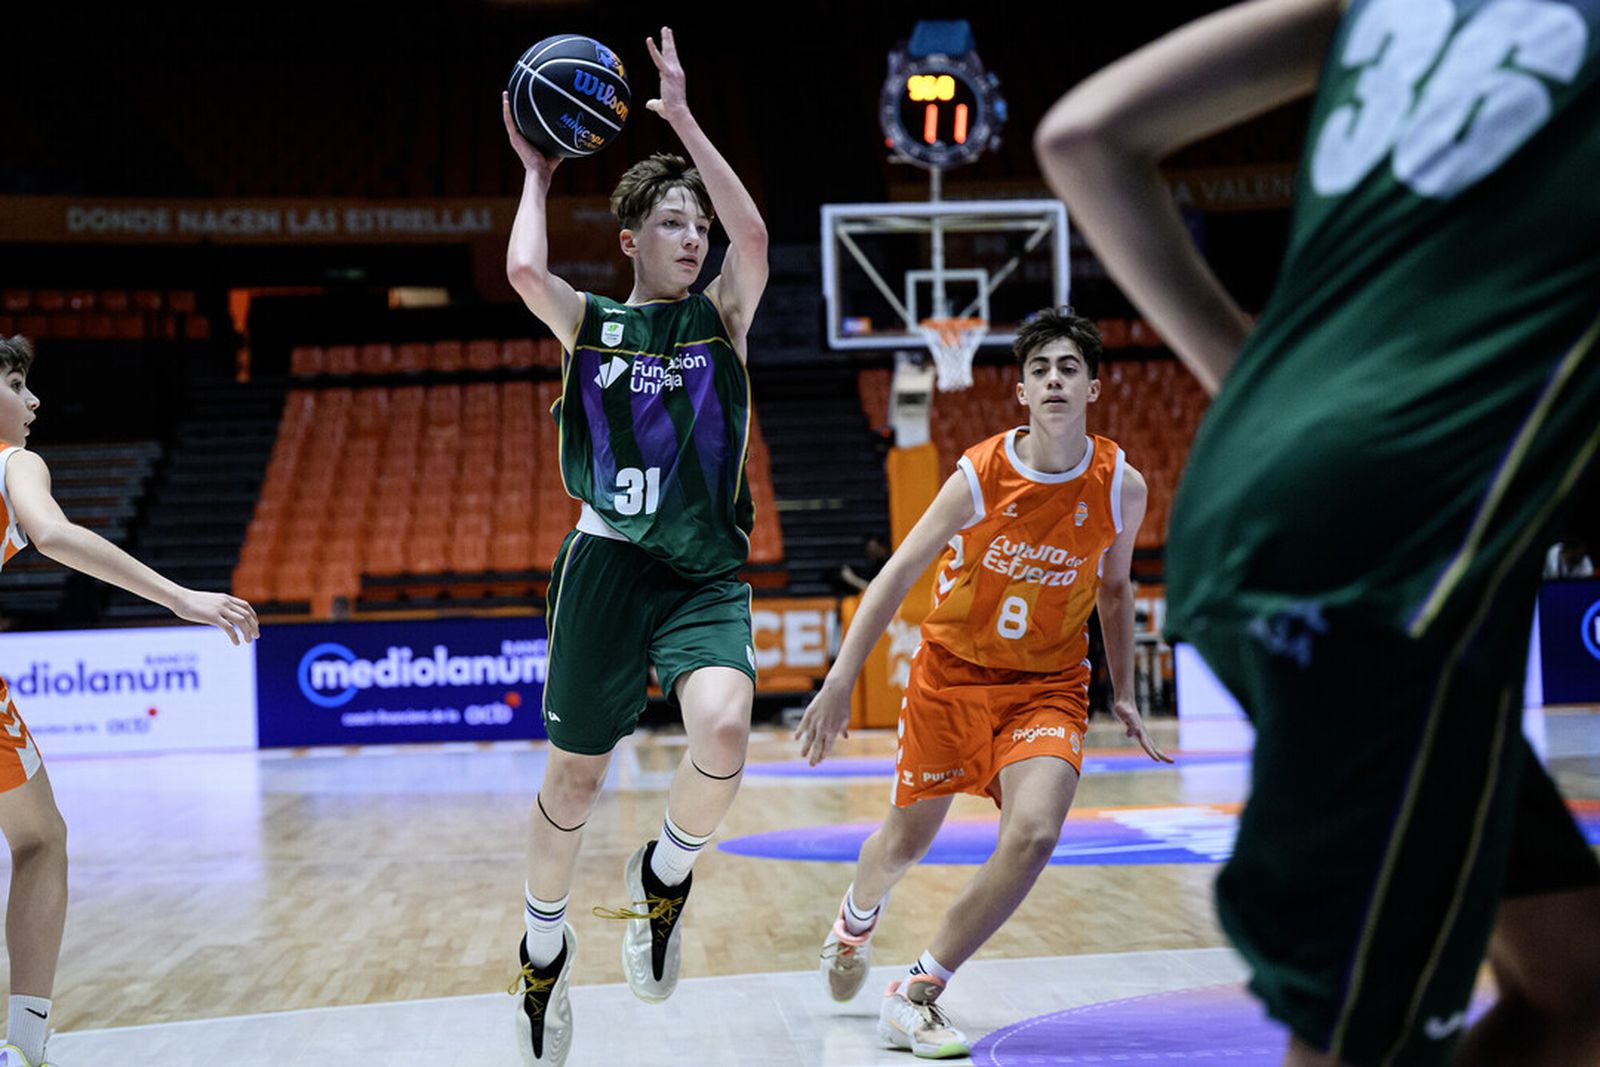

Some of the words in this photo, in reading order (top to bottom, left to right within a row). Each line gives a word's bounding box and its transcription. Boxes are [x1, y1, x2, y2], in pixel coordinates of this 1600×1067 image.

[573, 68, 629, 122] Wilson
[1311, 0, 1588, 199] 36
[924, 103, 968, 144] 11
[1200, 176, 1292, 202] VALEN
[66, 207, 169, 233] DONDE
[178, 207, 279, 233] NACEN
[344, 207, 492, 233] ESTRELLAS
[630, 372, 683, 396] Uniaja
[613, 466, 661, 516] 31
[996, 595, 1028, 640] 8
